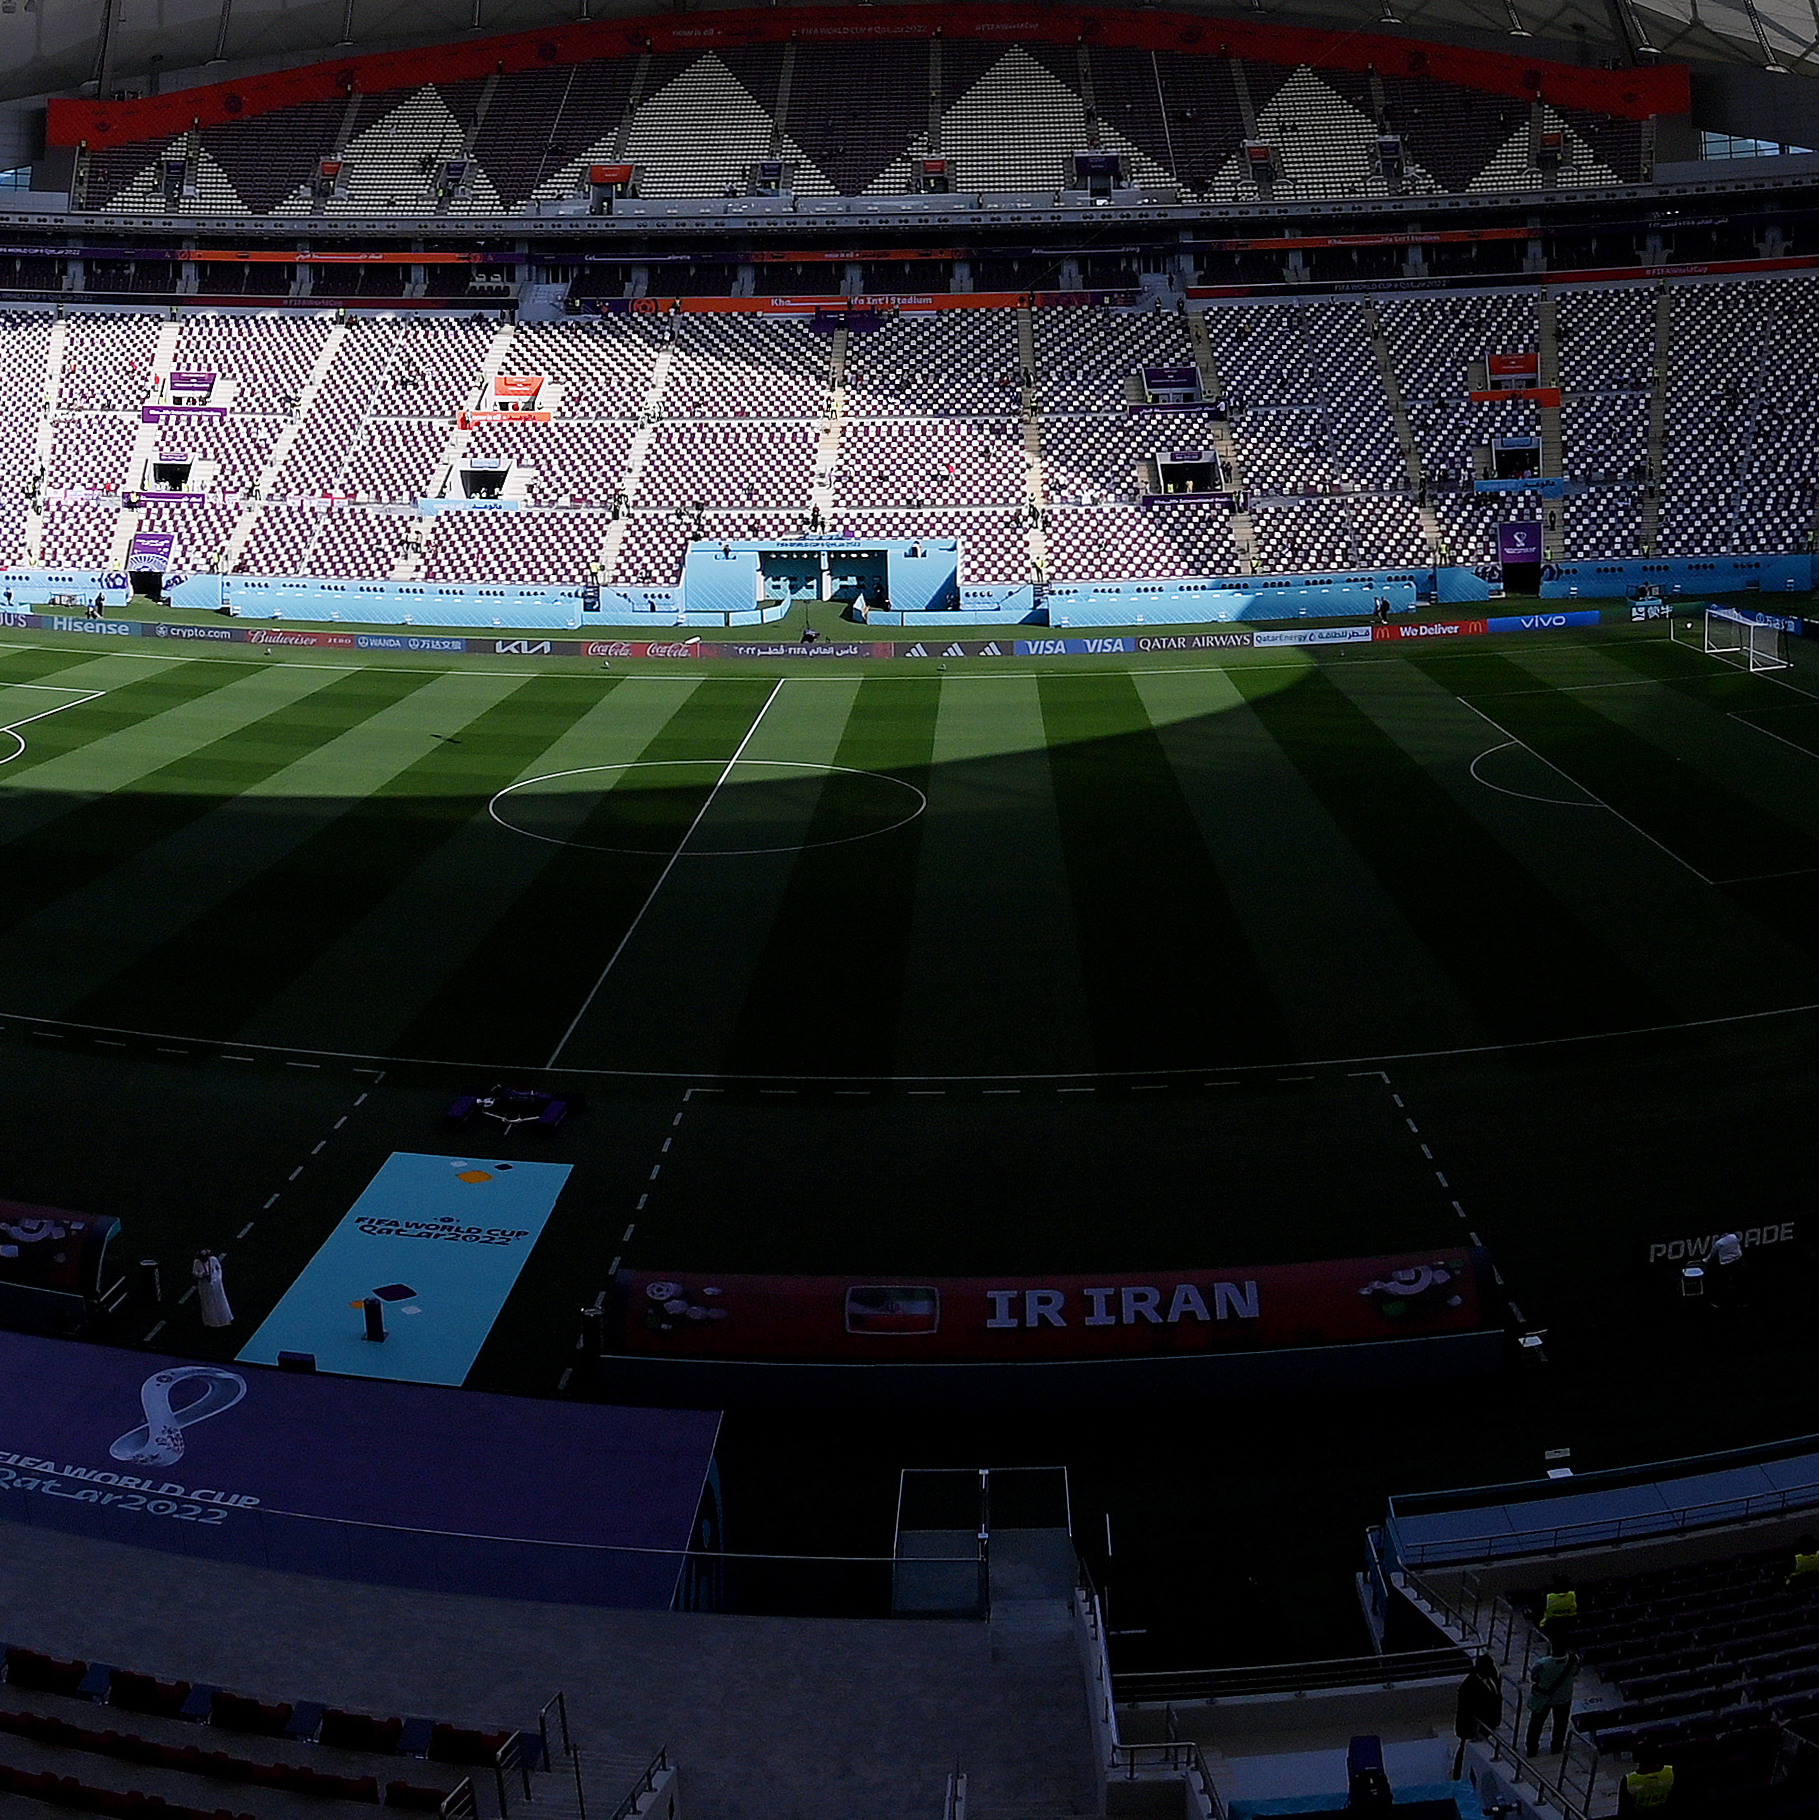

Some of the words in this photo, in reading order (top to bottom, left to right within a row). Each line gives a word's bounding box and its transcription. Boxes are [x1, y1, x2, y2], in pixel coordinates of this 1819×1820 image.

[818, 27, 849, 35] WORLD
[890, 295, 933, 304] Stadium
[53, 616, 130, 636] Hisense
[1519, 615, 1566, 629] vivo
[169, 626, 231, 639] crypto.com
[248, 629, 317, 646] Budweiser
[327, 637, 352, 645] ZERO
[1255, 631, 1307, 644] QatarEnergy
[1399, 625, 1418, 637] We
[1419, 623, 1459, 636] Deliver
[370, 638, 401, 648] WANDA
[495, 640, 551, 654] KIA
[587, 641, 632, 657] Coca-Cola
[646, 642, 691, 658] Coca-Cola
[1025, 640, 1066, 655] VISA
[1083, 638, 1124, 653] VISA
[1138, 637, 1186, 652] QATAR
[1191, 634, 1250, 648] AIRWAYS
[354, 1216, 400, 1227] FIFA
[404, 1221, 482, 1235] WORLD
[486, 1228, 530, 1238] CUP
[358, 1224, 512, 1246] Qatar2022
[1649, 1220, 1796, 1264] POWADE
[986, 1289, 1068, 1328] IR
[1083, 1280, 1260, 1326] IRAN
[62, 1464, 186, 1497] WORLD
[190, 1488, 261, 1508] CUP
